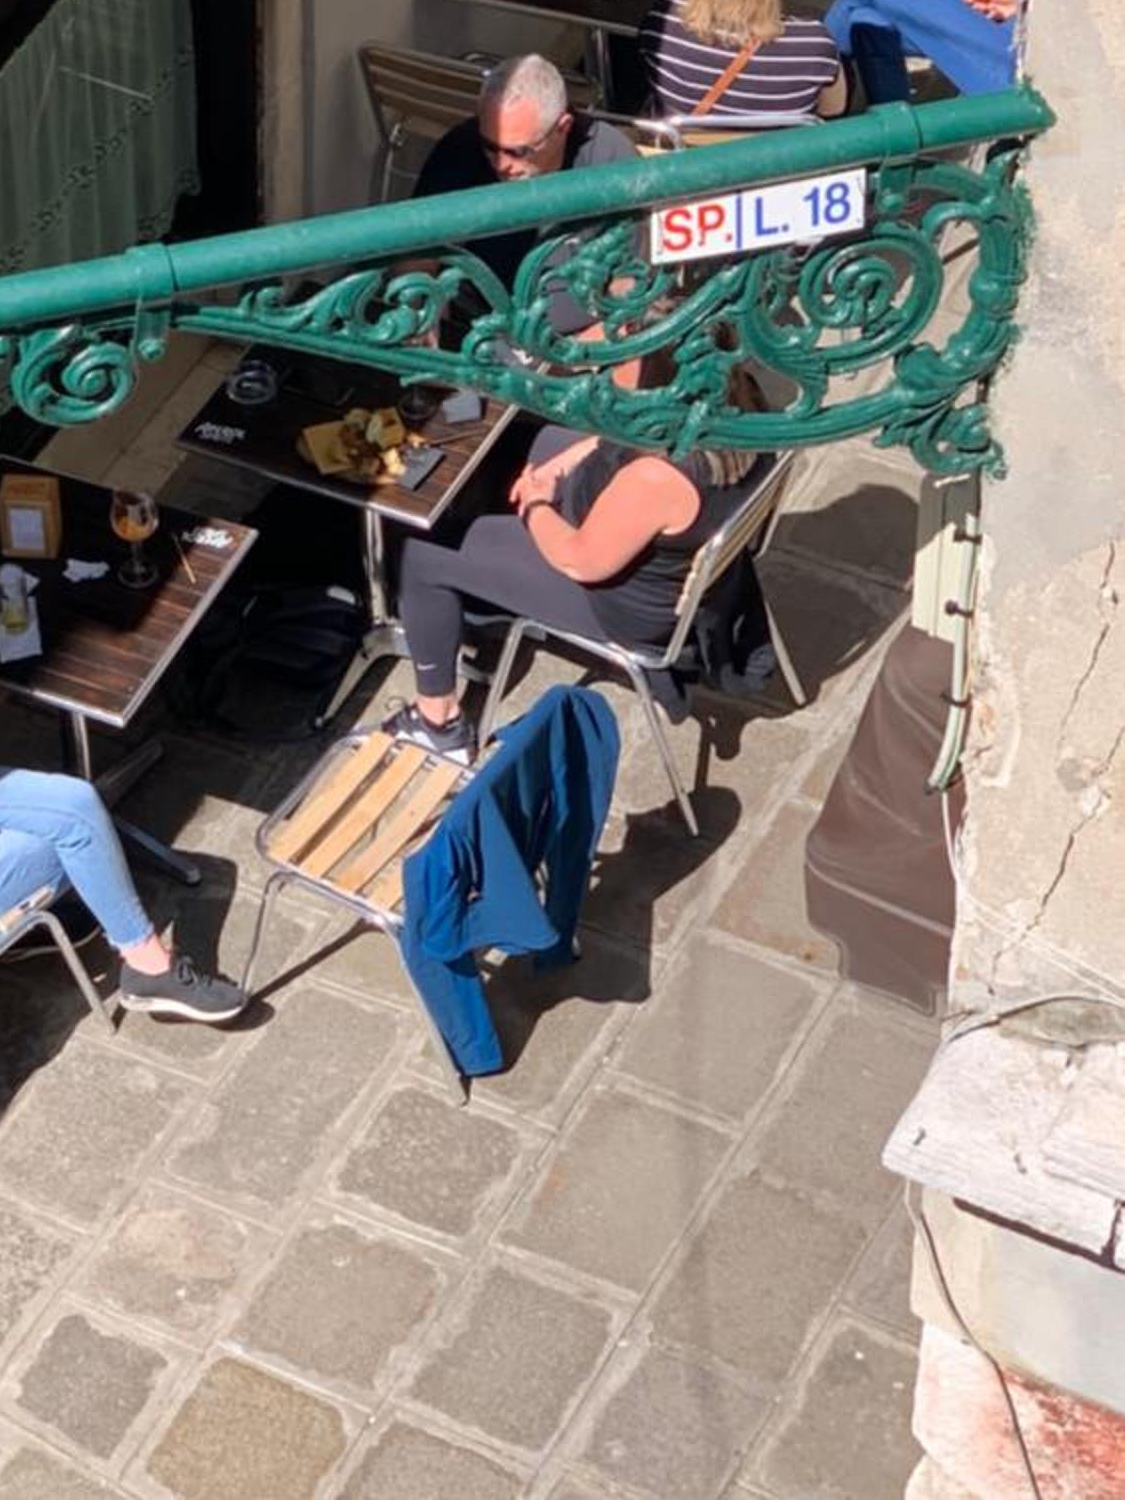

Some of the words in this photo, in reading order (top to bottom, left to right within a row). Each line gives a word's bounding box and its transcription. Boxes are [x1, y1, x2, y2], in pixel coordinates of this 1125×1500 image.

[662, 203, 733, 254] SP.
[755, 196, 790, 237] L.
[803, 182, 851, 227] 18
